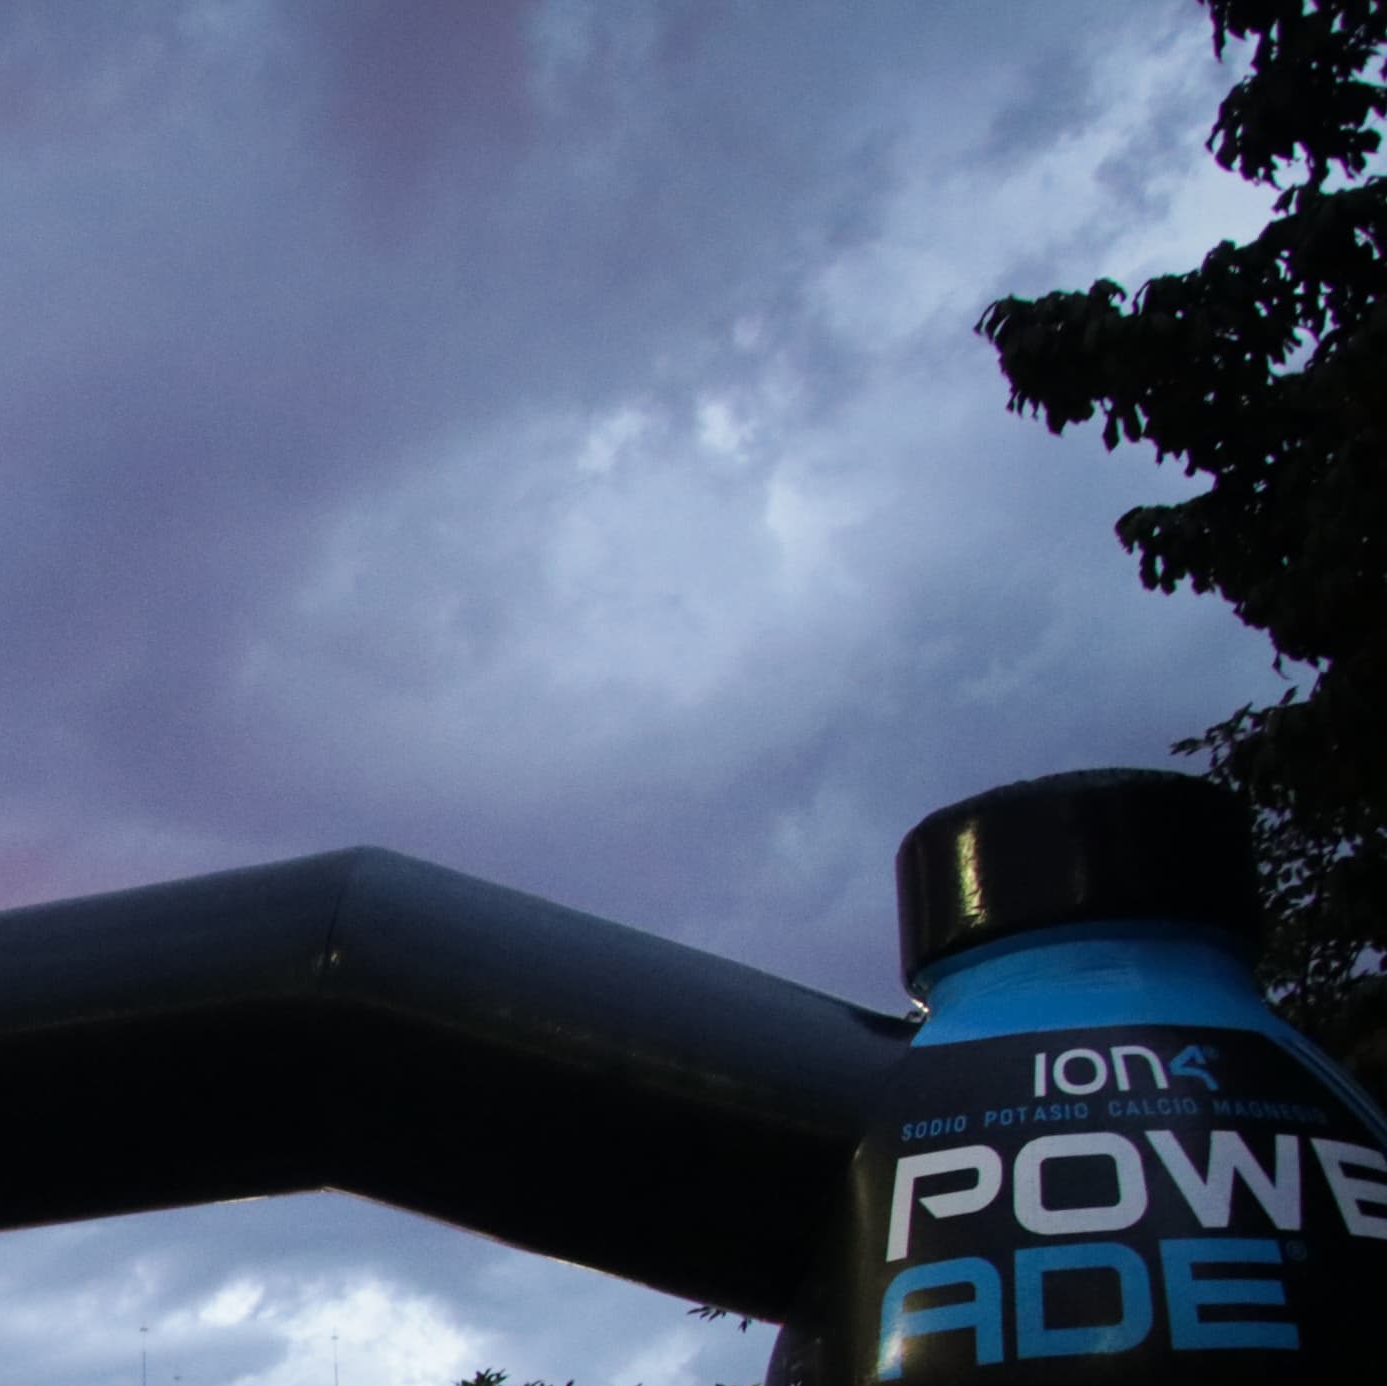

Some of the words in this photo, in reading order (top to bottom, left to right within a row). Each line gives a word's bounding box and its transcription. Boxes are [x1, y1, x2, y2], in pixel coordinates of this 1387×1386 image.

[900, 1118, 968, 1143] SODIO
[983, 1102, 1089, 1129] POTASIO
[1107, 1098, 1199, 1118] CALCIO
[877, 1238, 1301, 1382] ADE
